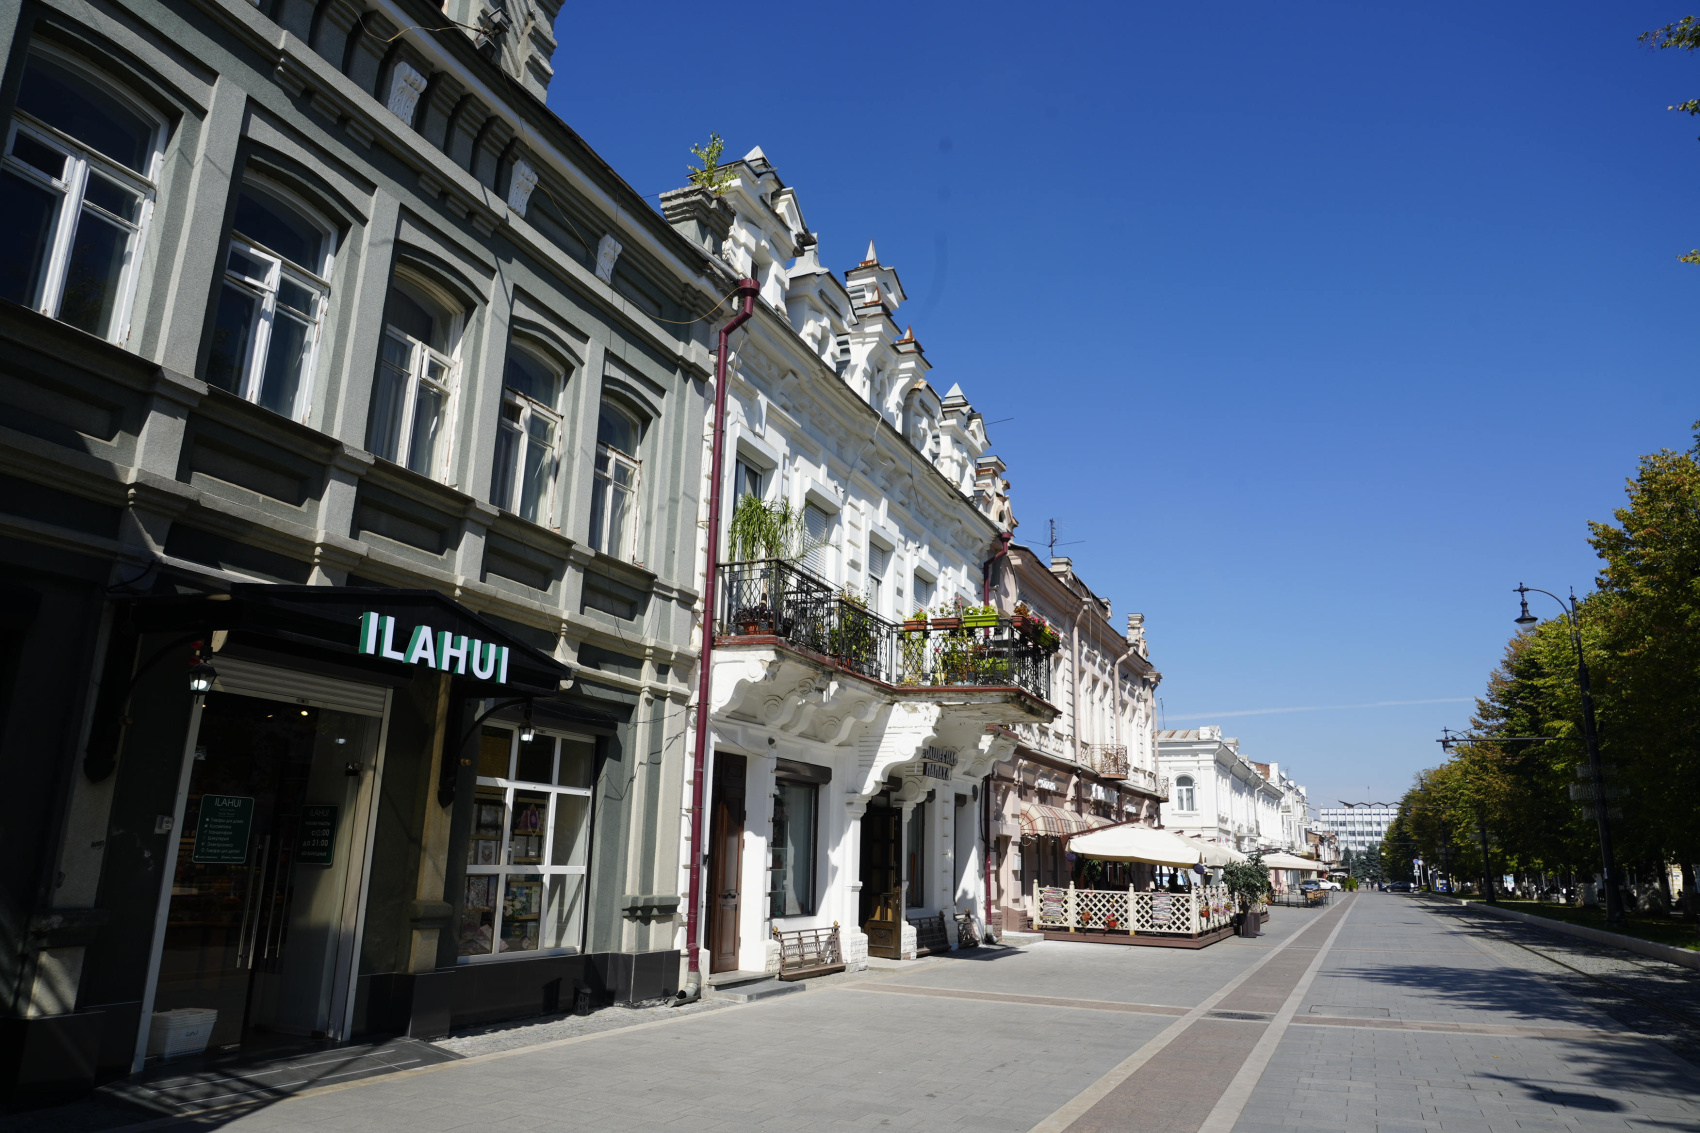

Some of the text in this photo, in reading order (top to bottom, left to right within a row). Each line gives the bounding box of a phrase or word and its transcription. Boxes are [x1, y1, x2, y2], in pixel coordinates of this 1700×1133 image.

[359, 611, 510, 684] ILAHUI
[926, 763, 951, 780] ПАПАХА
[214, 798, 242, 808] ILAHUI
[309, 808, 330, 817] ILAHUI
[311, 839, 329, 847] 21:00
